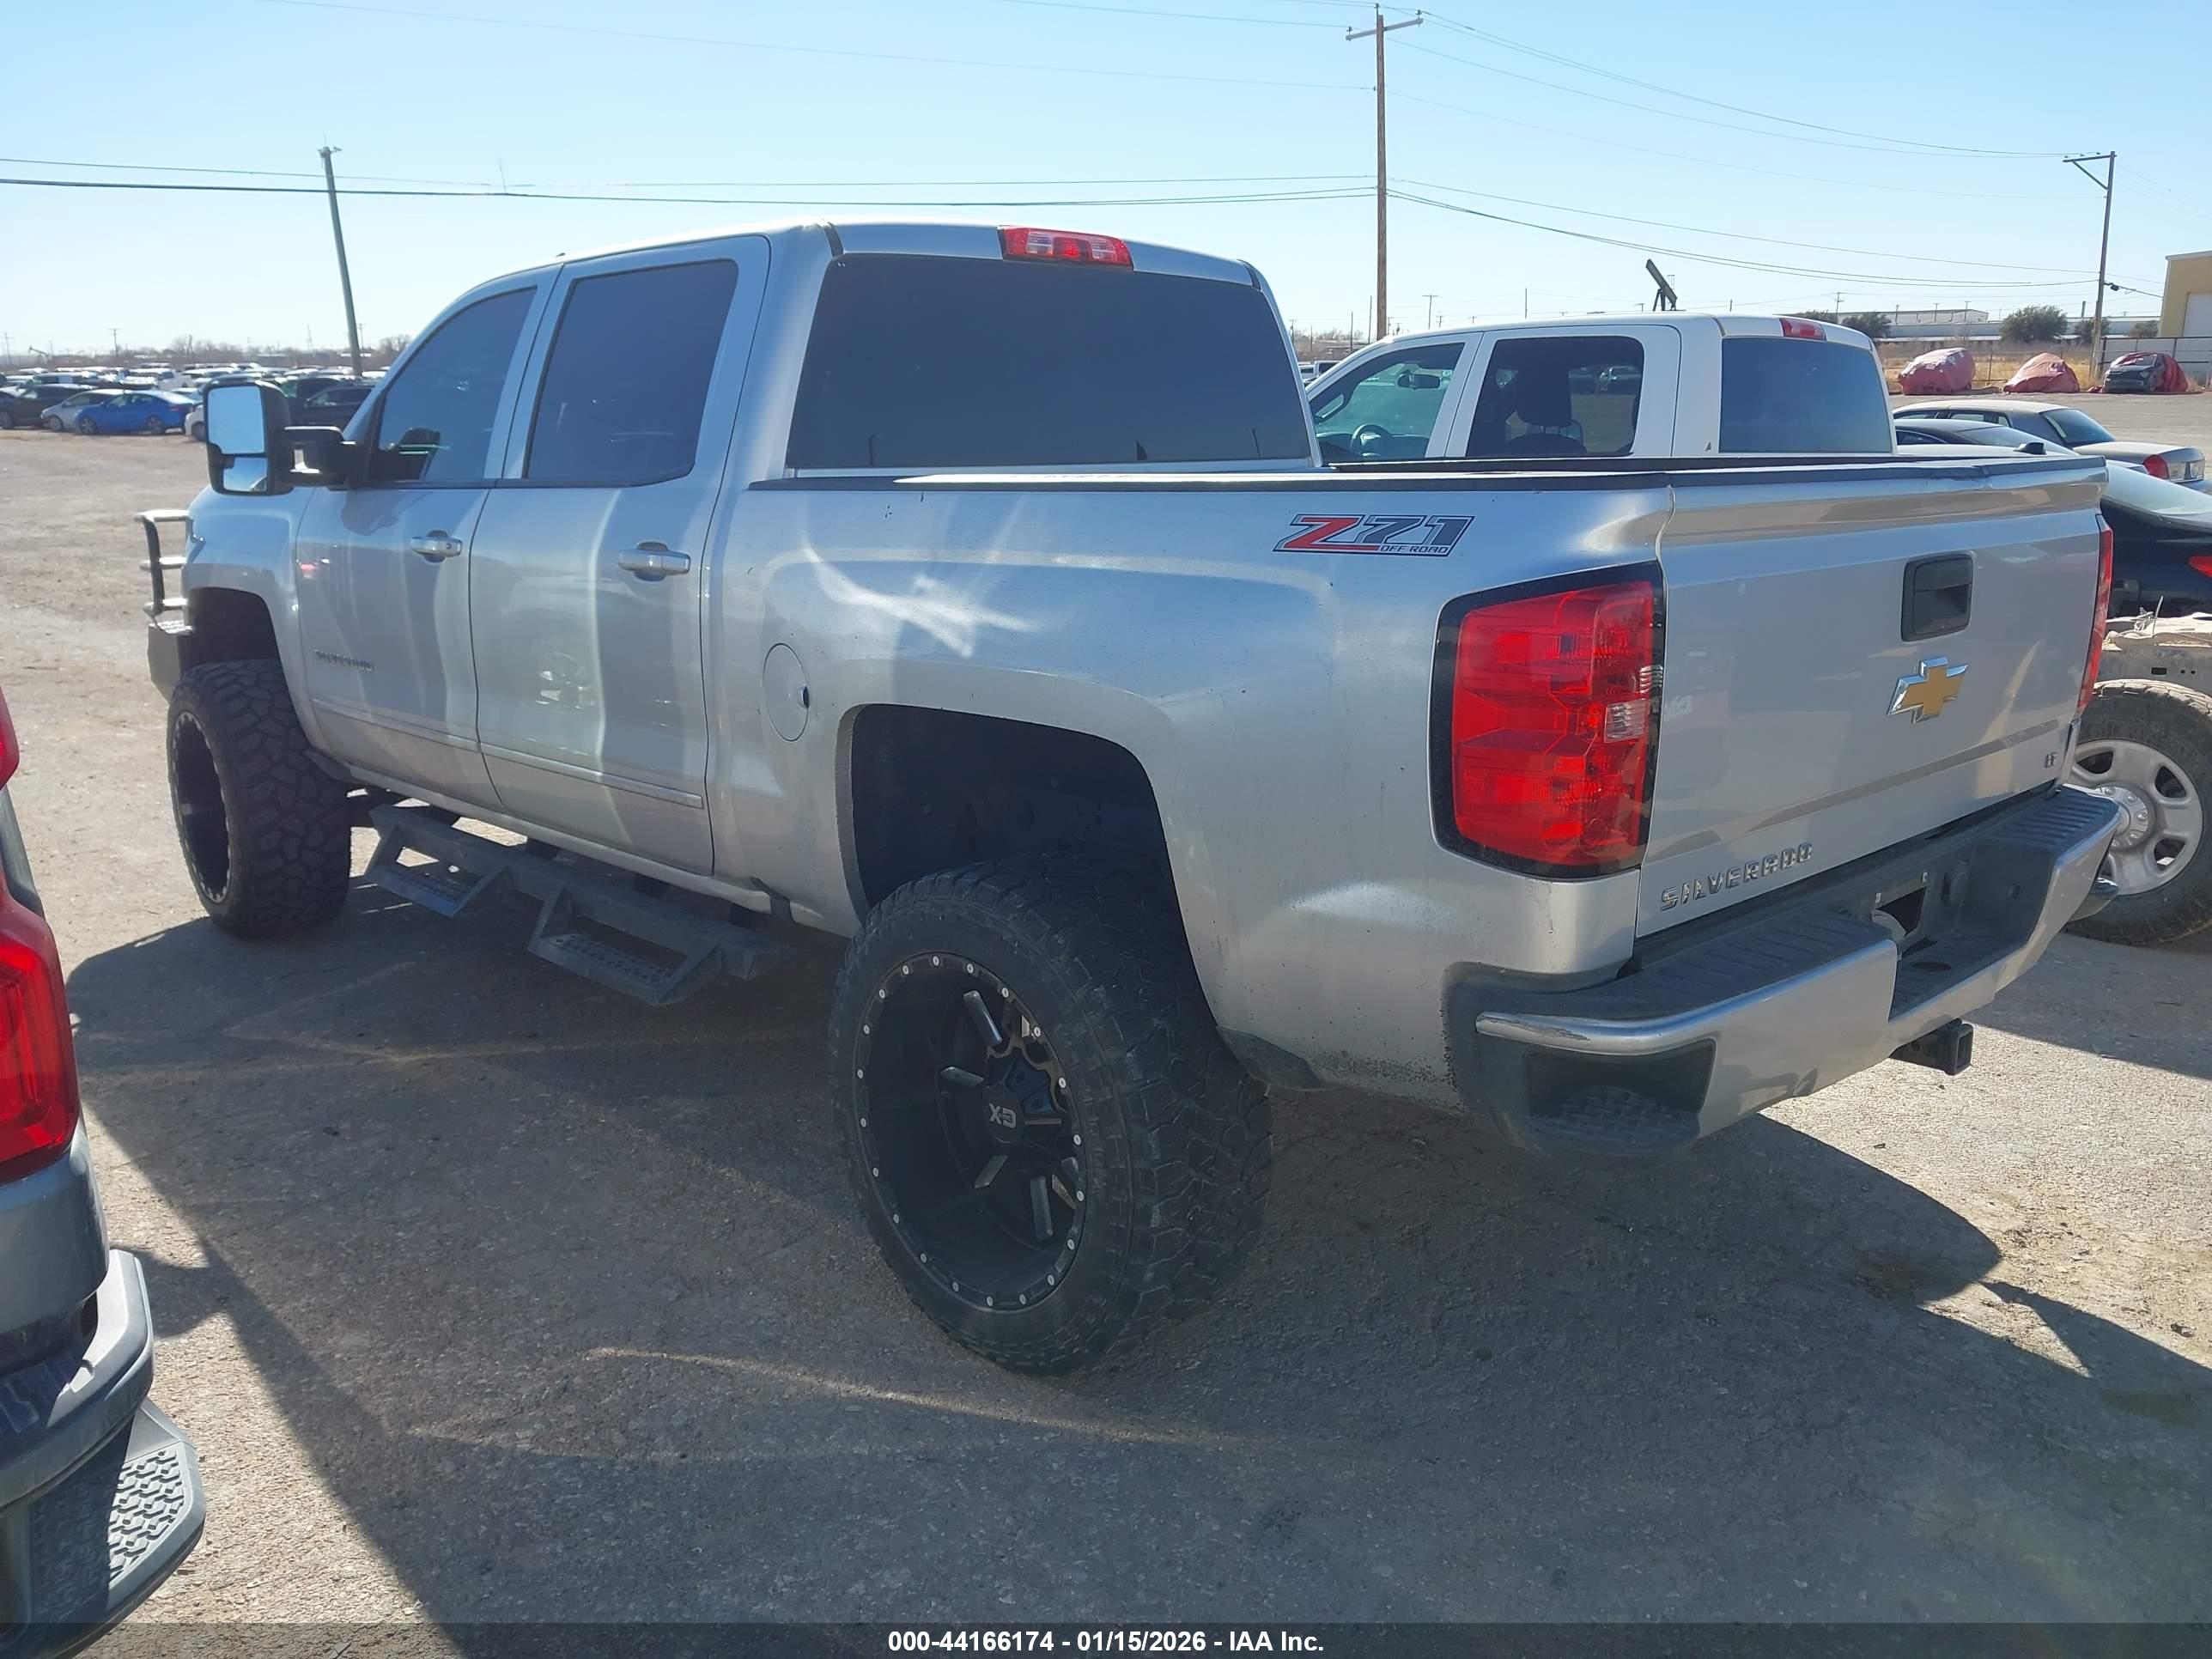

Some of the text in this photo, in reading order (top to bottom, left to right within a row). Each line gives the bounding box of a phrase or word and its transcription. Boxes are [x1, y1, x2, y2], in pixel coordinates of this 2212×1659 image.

[1273, 514, 1475, 556] Z71
[1409, 545, 1449, 554] ROAD
[1660, 842, 1813, 911] SILVERADO
